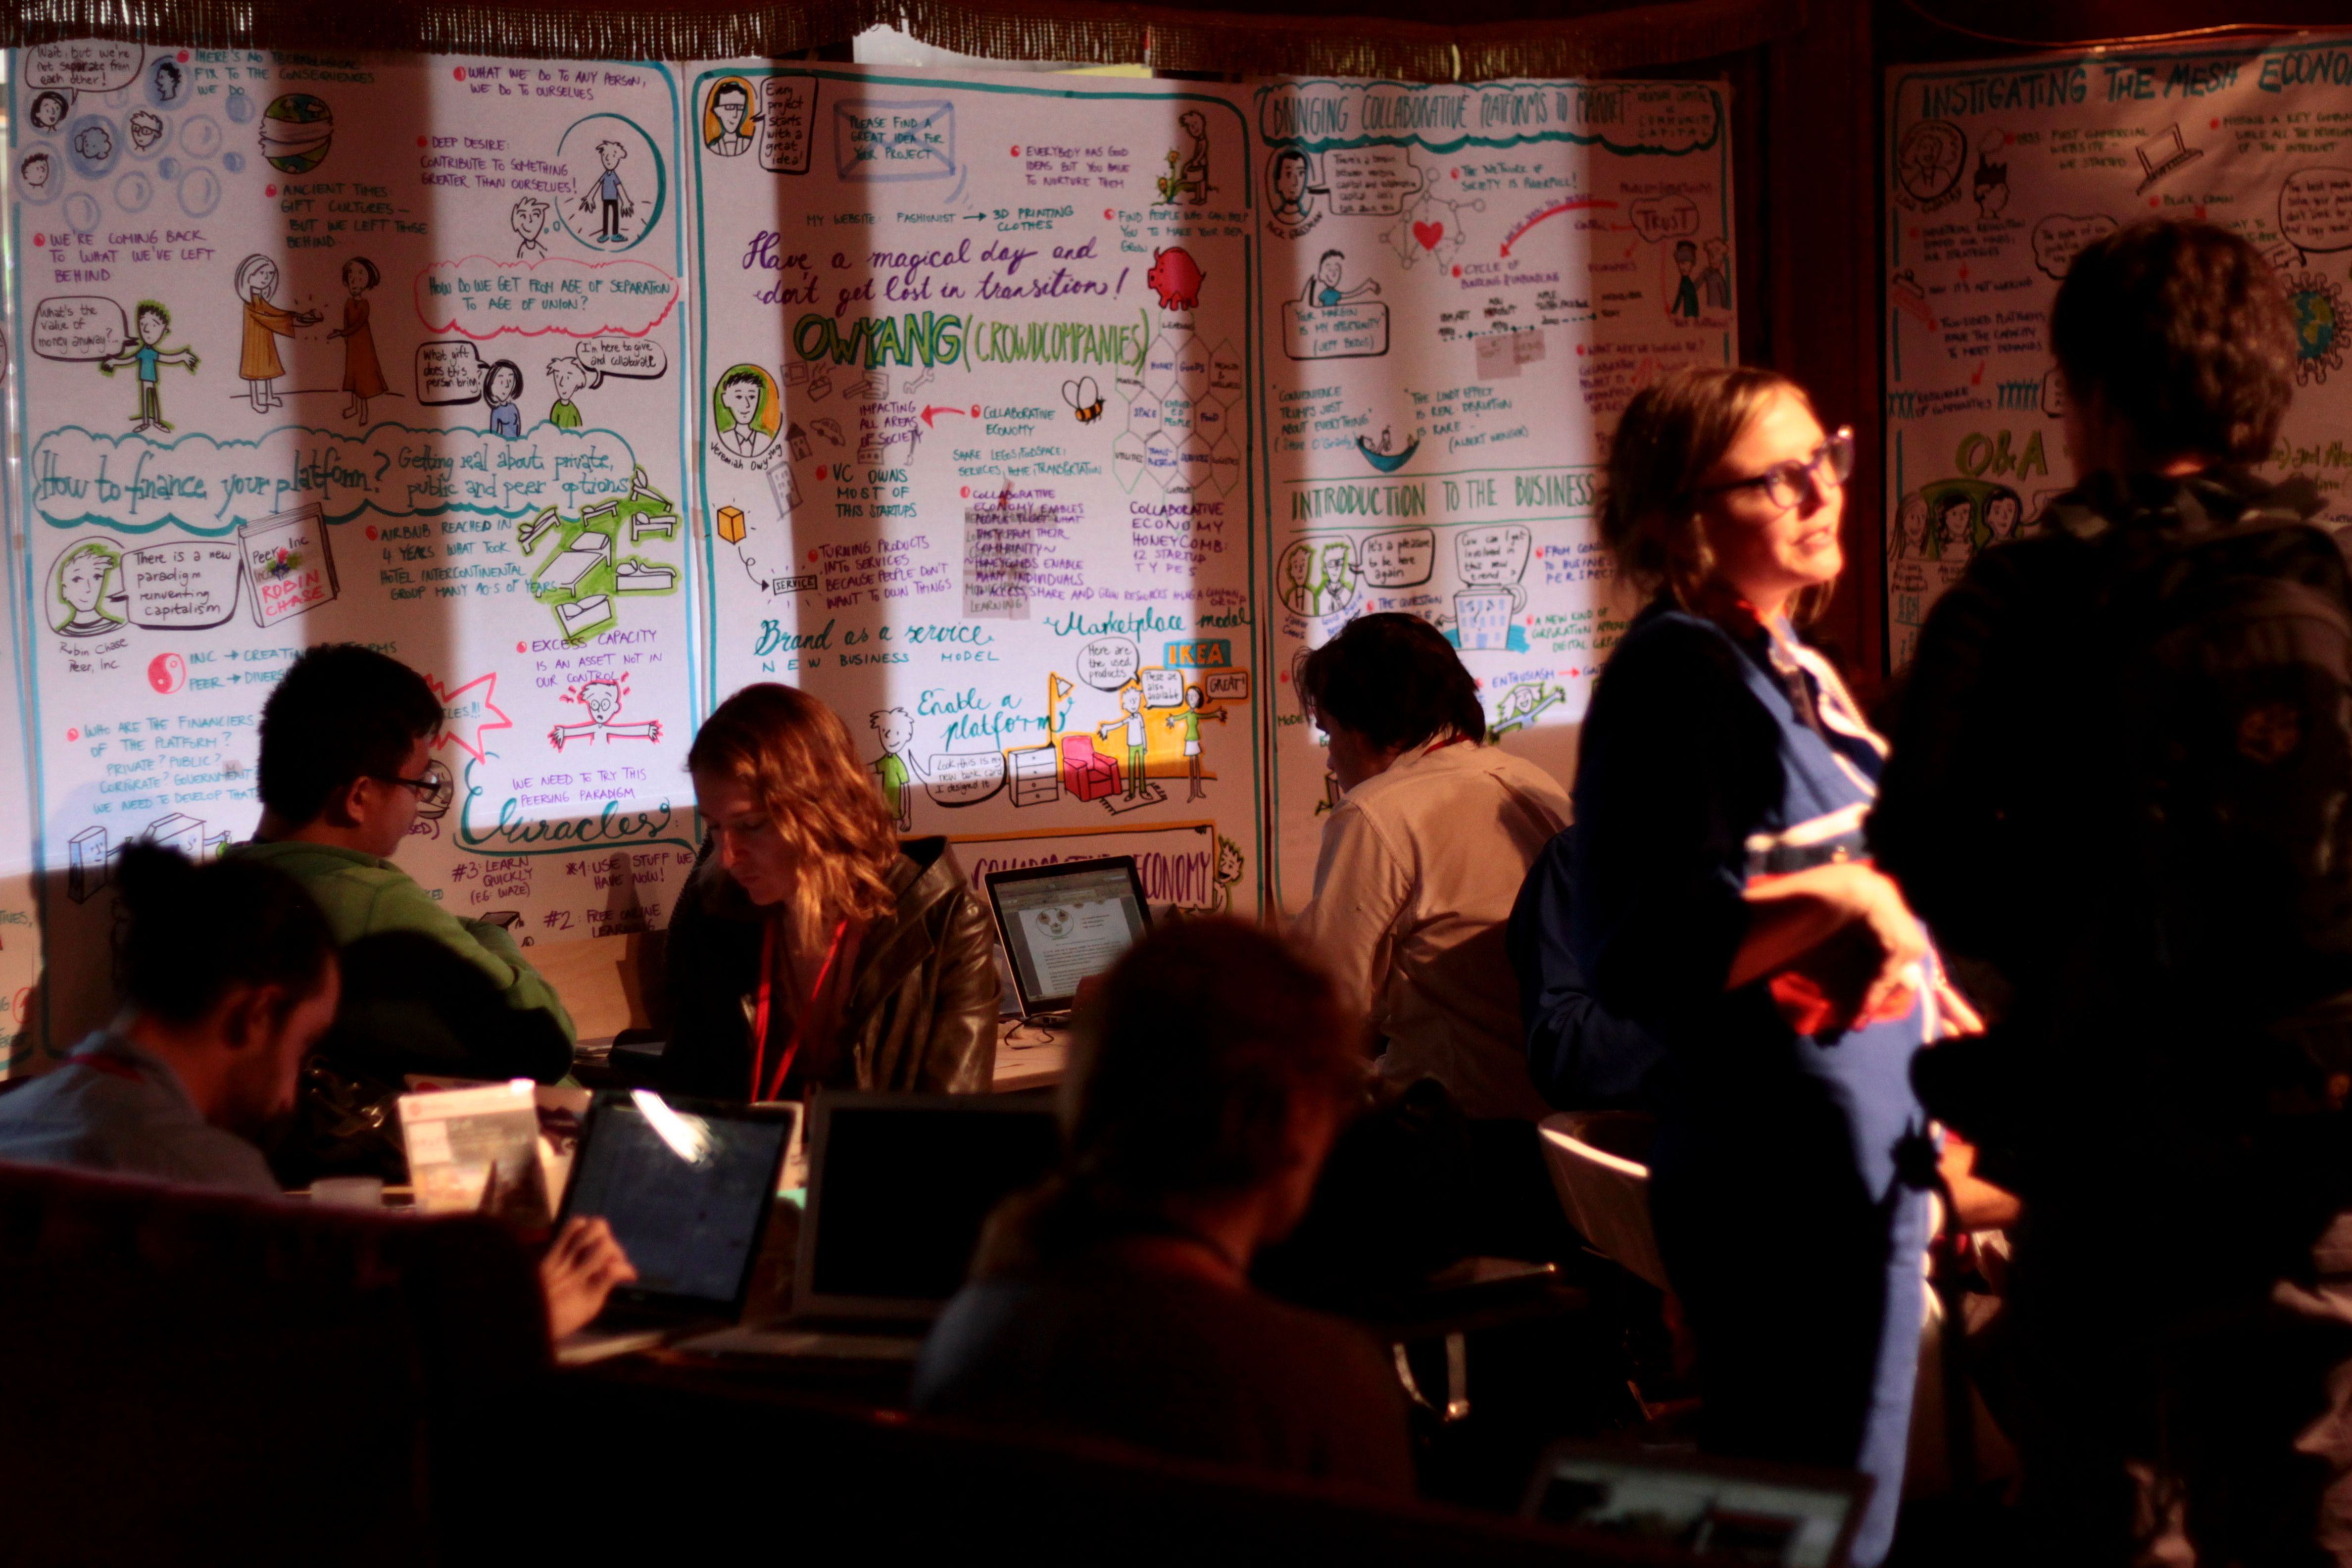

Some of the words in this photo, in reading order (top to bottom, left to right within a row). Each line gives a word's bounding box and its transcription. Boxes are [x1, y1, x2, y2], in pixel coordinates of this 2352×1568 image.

[469, 67, 500, 79] WHAT
[509, 69, 531, 80] WE
[575, 70, 597, 82] ANY
[471, 84, 490, 94] WE
[1923, 69, 2087, 119] INSTIGATING
[2104, 66, 2155, 102] THE
[2164, 62, 2239, 98] MESH
[2258, 50, 2352, 93] ECONO
[433, 137, 458, 148] DEEP
[422, 174, 469, 188] GREATER
[475, 176, 505, 188] THAN
[993, 209, 1009, 220] 3D
[1019, 206, 1074, 218] PRINTING
[166, 230, 205, 243] BACK
[80, 250, 117, 263] WHAT
[133, 247, 171, 262] WE'VE
[180, 248, 215, 262] LEFT
[742, 231, 812, 271] Have
[832, 252, 852, 270] a
[868, 238, 971, 285] magical
[981, 239, 1039, 275] day
[1052, 236, 1098, 260] and
[55, 269, 110, 283] BEHIND
[497, 277, 522, 292] GET
[561, 278, 582, 293] AGE
[885, 277, 931, 300] lost
[939, 279, 965, 299] in
[489, 298, 511, 310] AGE
[793, 311, 963, 370] OWYANG
[859, 401, 916, 415] IMPACTING
[833, 464, 854, 481] VC
[868, 469, 908, 483] OWNS
[837, 487, 886, 499] MOST
[892, 487, 910, 498] OF
[1291, 483, 1426, 521] INTRODUCTION
[1442, 480, 1460, 511] TO
[1466, 479, 1497, 506] THE
[1516, 474, 1595, 506] BUSINESS
[835, 503, 864, 517] THIS
[174, 549, 184, 561] is
[194, 551, 200, 561] a
[209, 551, 232, 560] new
[262, 570, 320, 602] ROBIN
[776, 578, 815, 590] SERVICE
[265, 586, 325, 616] CHASE
[532, 639, 588, 652] EXCESS
[598, 630, 657, 645] CAPACITY
[754, 619, 835, 656] Brand
[536, 660, 547, 671] IS
[556, 659, 570, 669] AN
[579, 654, 617, 666] ASSET
[649, 653, 662, 662] IN
[762, 658, 821, 672] NEW
[840, 653, 910, 666] BUSINESS
[1169, 644, 1225, 665] IKEA
[536, 675, 557, 687] OUR
[513, 778, 533, 790] WE
[541, 774, 573, 785] NEED
[597, 770, 617, 781] TRY
[621, 767, 647, 780] THIS
[486, 856, 529, 873] LEARN
[592, 859, 620, 874] USE
[633, 854, 670, 867] STUFF
[483, 868, 533, 887] QUICKLY
[594, 873, 623, 890] HAVE
